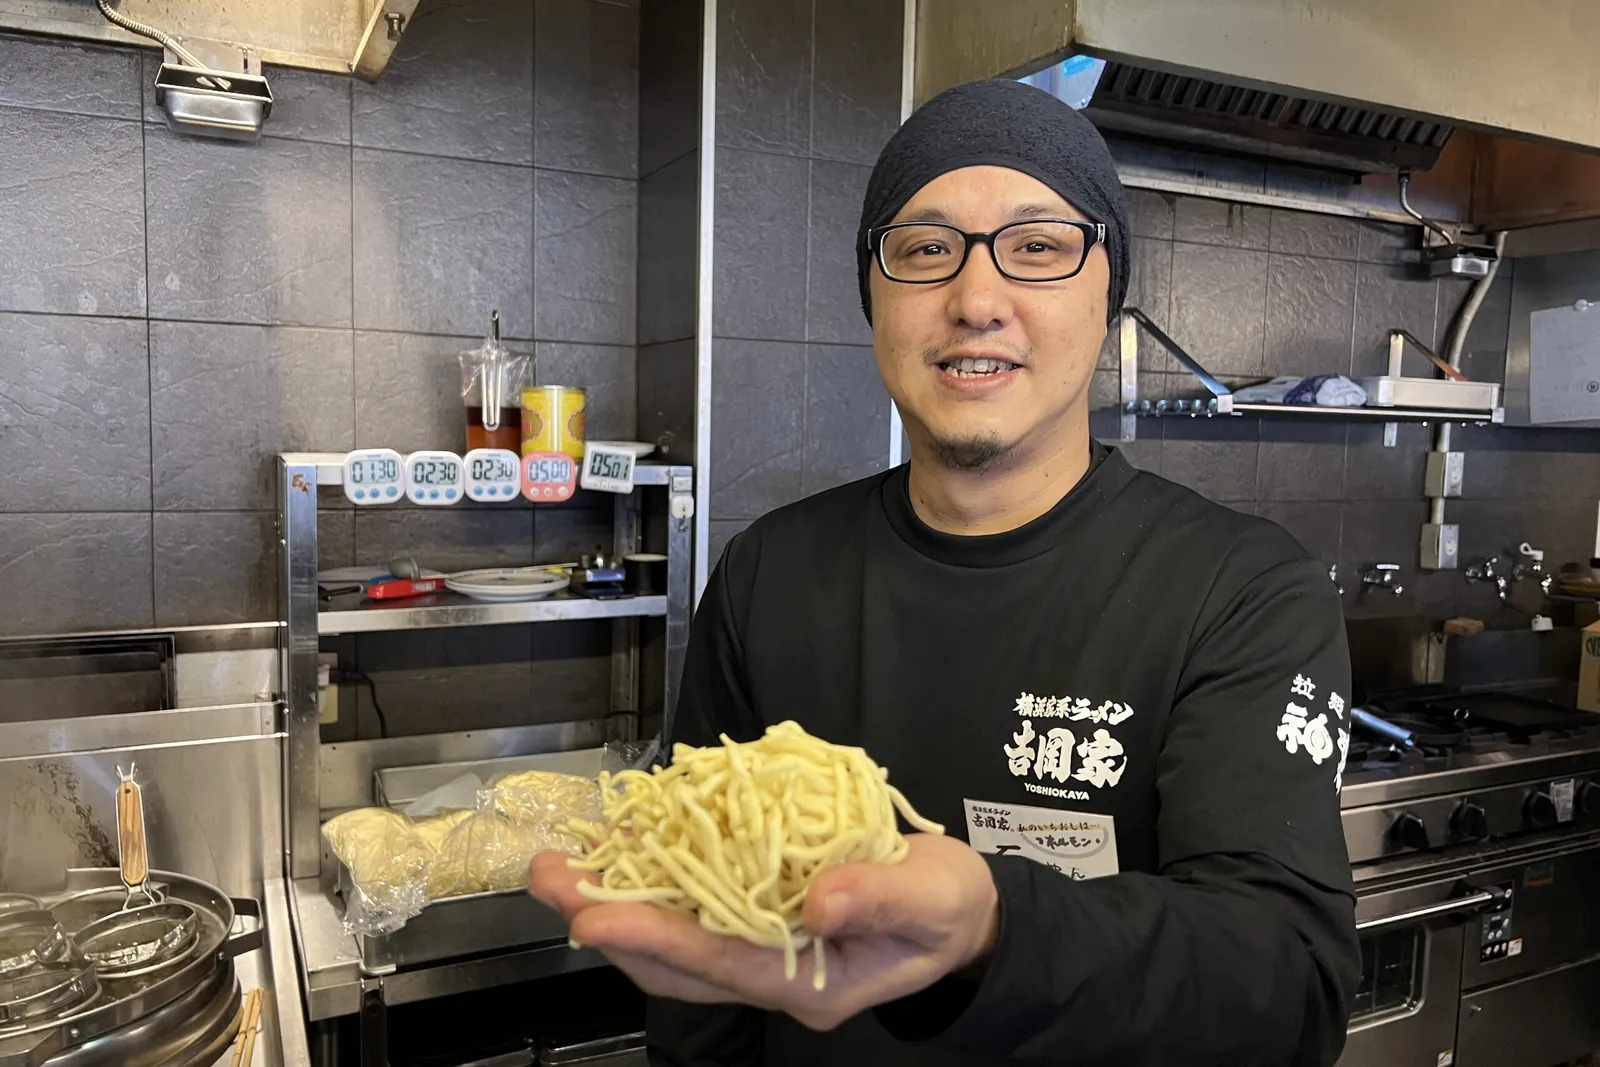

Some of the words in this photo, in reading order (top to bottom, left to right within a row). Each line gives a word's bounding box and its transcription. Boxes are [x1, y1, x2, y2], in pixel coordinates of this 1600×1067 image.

[1003, 719, 1128, 788] 吉岡家
[1024, 782, 1090, 801] YOSHIOKAYA
[971, 813, 1011, 831] 吉岡家
